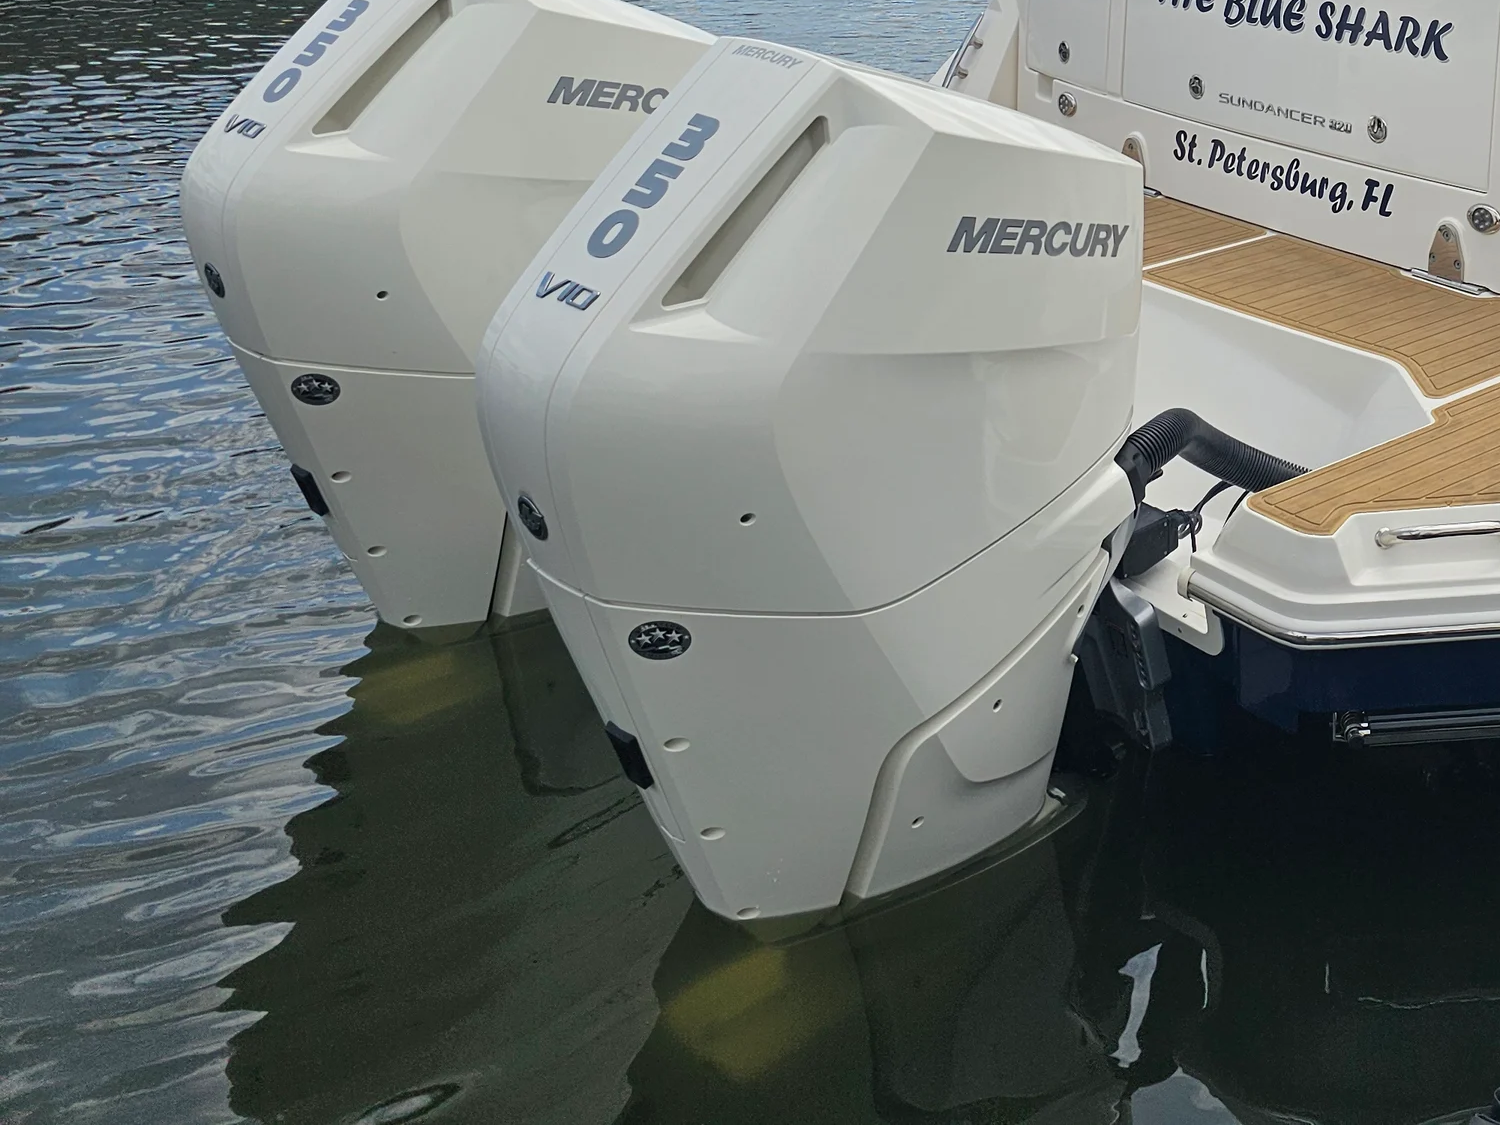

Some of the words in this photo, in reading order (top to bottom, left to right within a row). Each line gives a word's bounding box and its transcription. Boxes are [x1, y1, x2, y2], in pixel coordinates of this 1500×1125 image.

[1315, 0, 1454, 62] SHARK
[732, 44, 804, 70] MERCURY
[546, 75, 670, 115] MERC
[1218, 92, 1326, 128] SUNDANCER
[223, 113, 268, 140] V10
[586, 112, 721, 260] 350
[1172, 129, 1203, 166] St.
[1207, 138, 1355, 214] Petersburg,
[1361, 177, 1396, 219] FL
[946, 216, 1130, 259] MERCURY
[536, 270, 601, 312] V10
